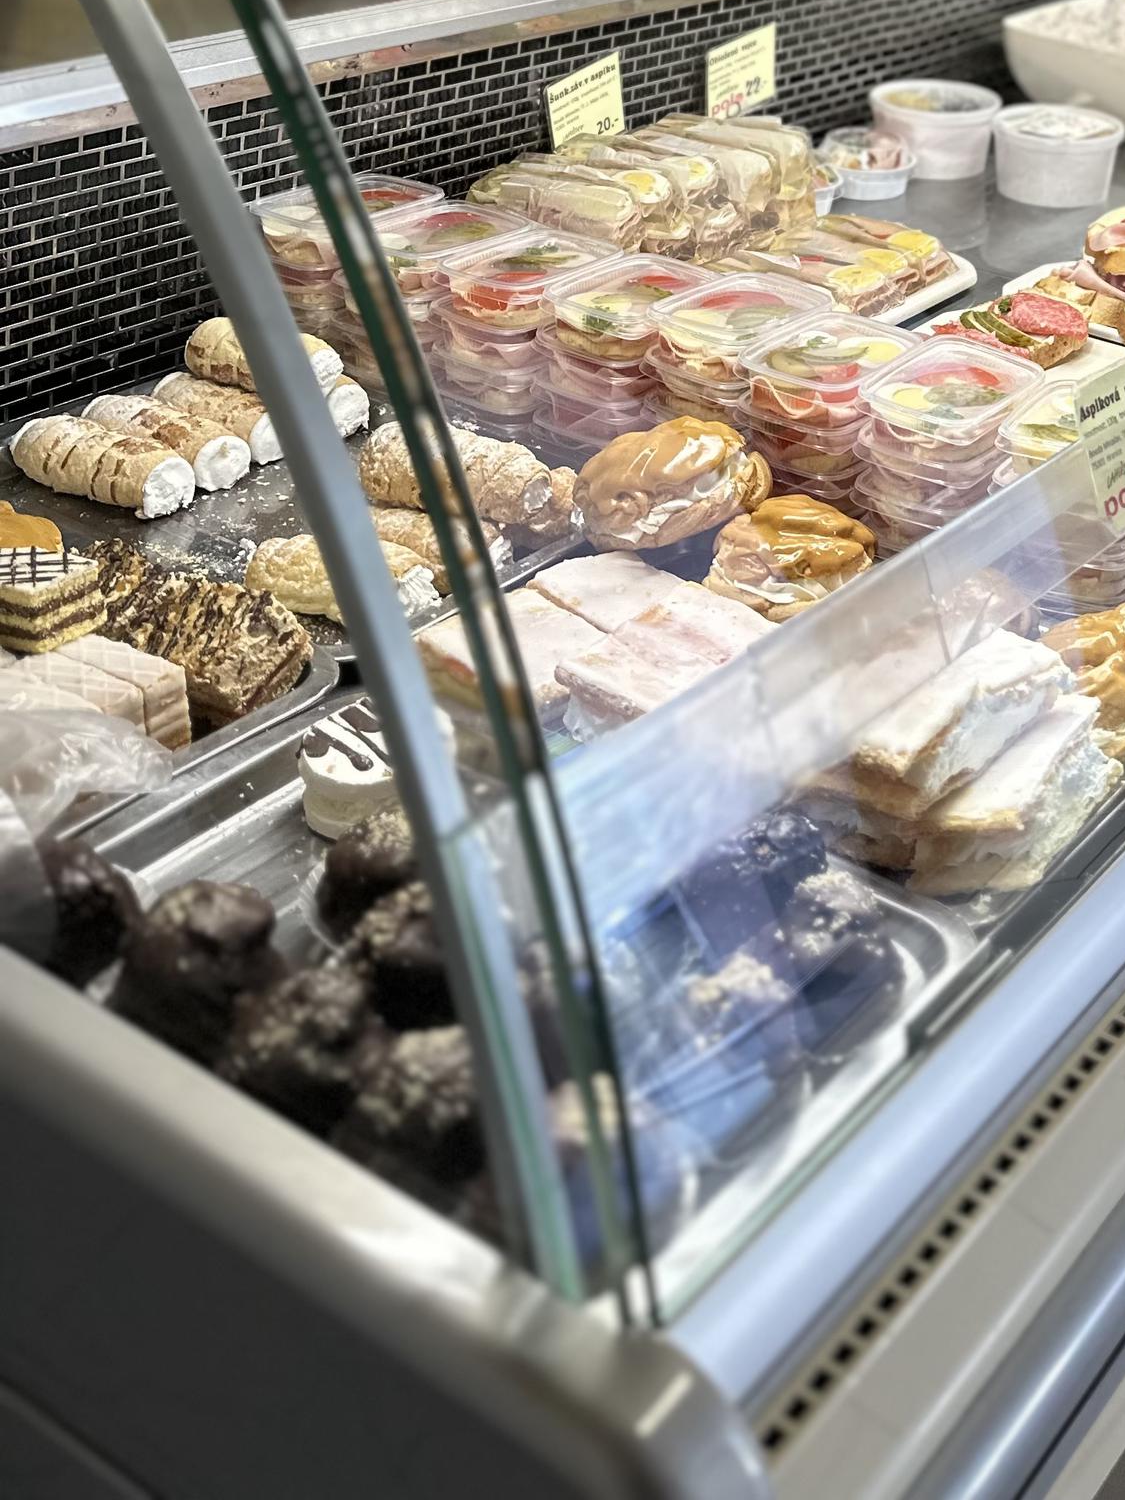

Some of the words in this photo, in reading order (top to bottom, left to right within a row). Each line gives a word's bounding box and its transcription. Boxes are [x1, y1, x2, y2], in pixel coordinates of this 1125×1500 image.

[591, 64, 616, 81] aspiku
[597, 116, 619, 135] 20.-
[1079, 386, 1121, 422] Aspiková
